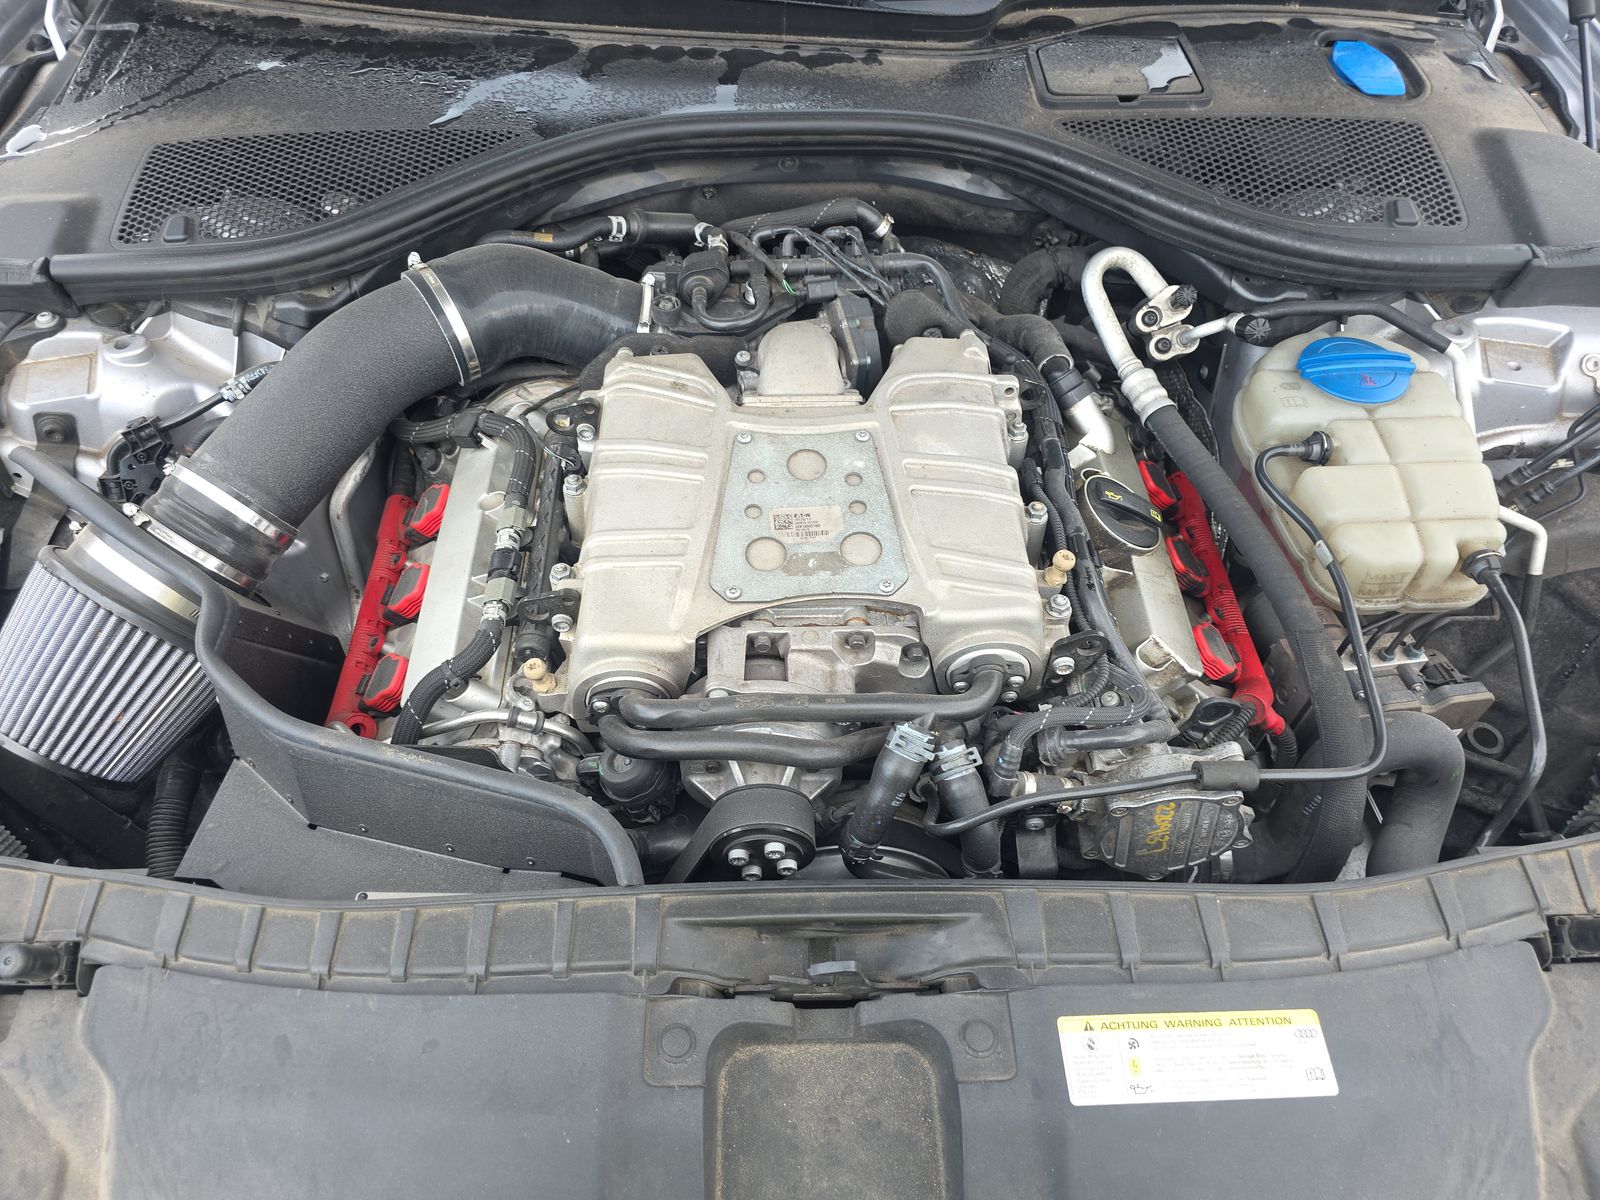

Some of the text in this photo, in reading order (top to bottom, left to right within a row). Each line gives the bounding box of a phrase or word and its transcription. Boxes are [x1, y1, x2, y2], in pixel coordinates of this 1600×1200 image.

[1100, 1016, 1292, 1031] ACHTUNG WARNING ATTENTION
